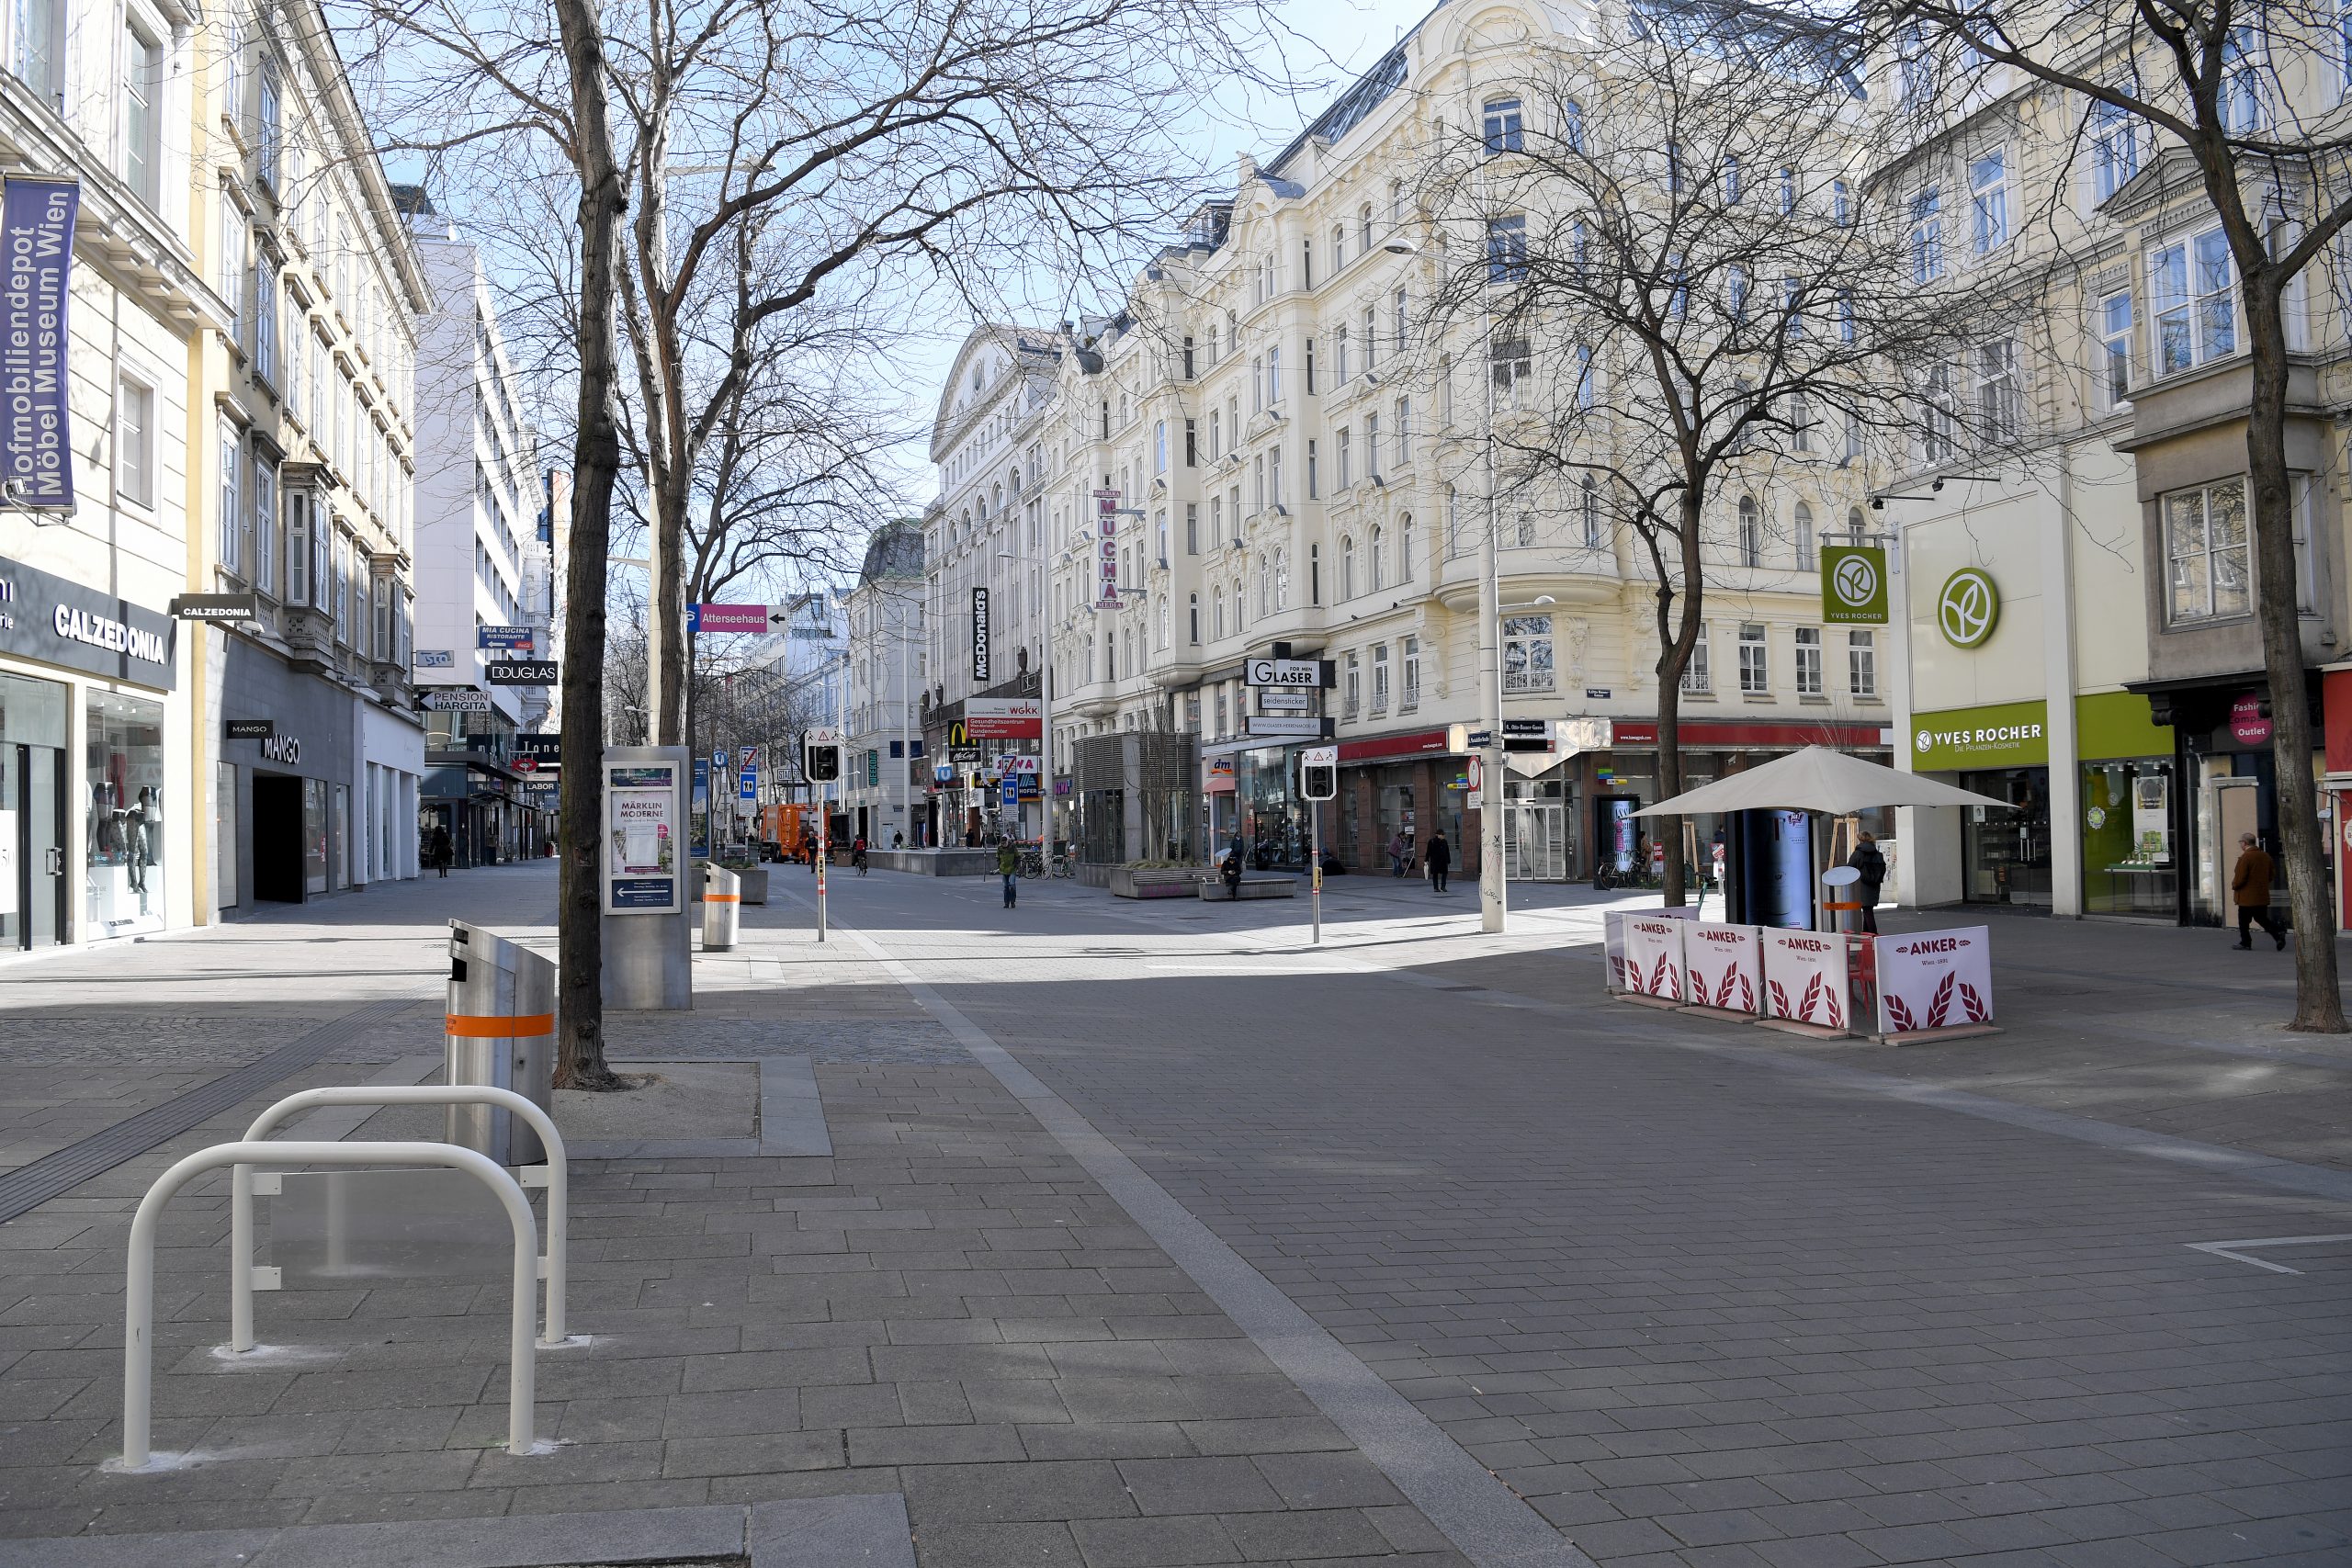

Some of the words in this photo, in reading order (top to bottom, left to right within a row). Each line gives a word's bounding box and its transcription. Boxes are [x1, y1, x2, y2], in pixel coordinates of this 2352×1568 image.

[36, 191, 69, 258] Wien
[34, 267, 61, 393] Museum
[34, 404, 63, 496] Möbel
[184, 607, 252, 617] CALZEDONIA
[702, 613, 765, 624] Atterseehaus
[53, 604, 165, 664] CALZEDONIA
[975, 590, 987, 678] McDonald's
[492, 666, 556, 680] DOUGLAS
[1255, 661, 1313, 683] GLASER
[434, 693, 488, 702] PENSION
[435, 701, 487, 710] HARGITA
[1934, 730, 1971, 746] YVES
[1976, 723, 2041, 743] ROCHER
[2238, 727, 2266, 736] Outlet
[265, 733, 300, 765] MANGO
[1214, 759, 1230, 769] dm
[940, 769, 952, 780] U
[621, 801, 662, 809] MÄRKLIN
[1641, 922, 1667, 935] ANKER
[1706, 931, 1737, 943] ANKER
[1788, 937, 1822, 953] ANKER
[1910, 937, 1957, 956] ANKER
